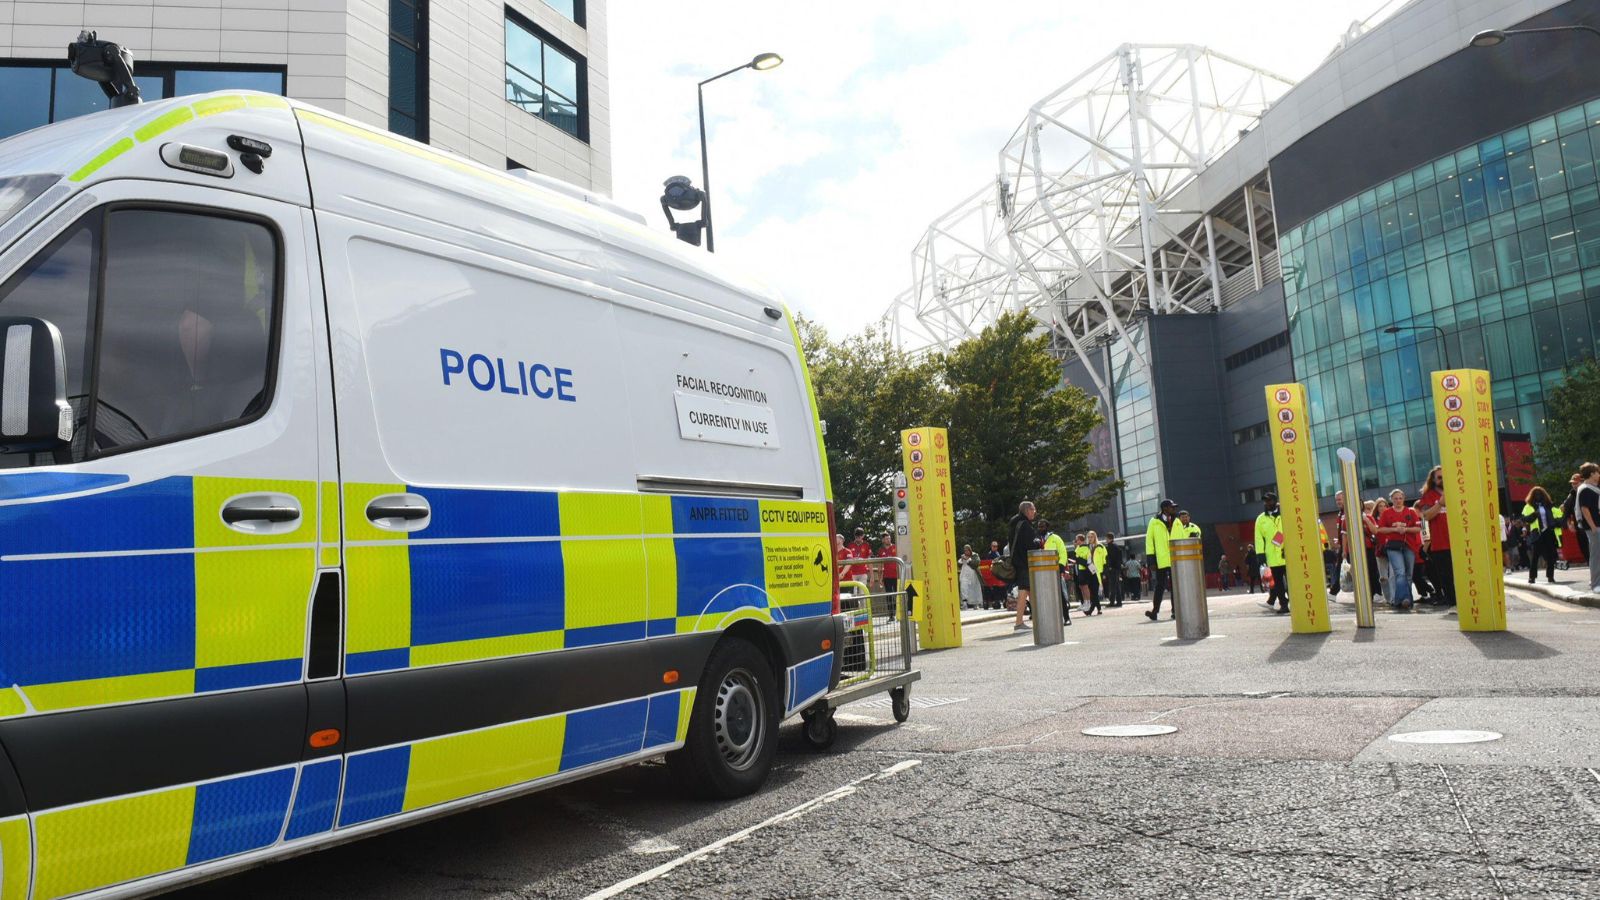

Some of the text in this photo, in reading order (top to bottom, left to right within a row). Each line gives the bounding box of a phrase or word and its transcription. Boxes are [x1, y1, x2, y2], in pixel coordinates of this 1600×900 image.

[440, 348, 576, 402] POLICE
[677, 375, 767, 403] FACIAL RECOGNITION
[689, 411, 769, 434] CURRENTLY IN USE
[1478, 418, 1491, 429] SAFE
[916, 486, 923, 500] NO
[1484, 436, 1497, 566] REPORT
[690, 507, 749, 521] ANPR FITTED
[762, 510, 826, 523] CCTV EQUIPPED
[1286, 449, 1315, 626] NO BAGS PAST THIS POINT
[1453, 438, 1479, 624] NO BAGS PAST THIS POINT
[941, 483, 957, 639] REPORT IT
